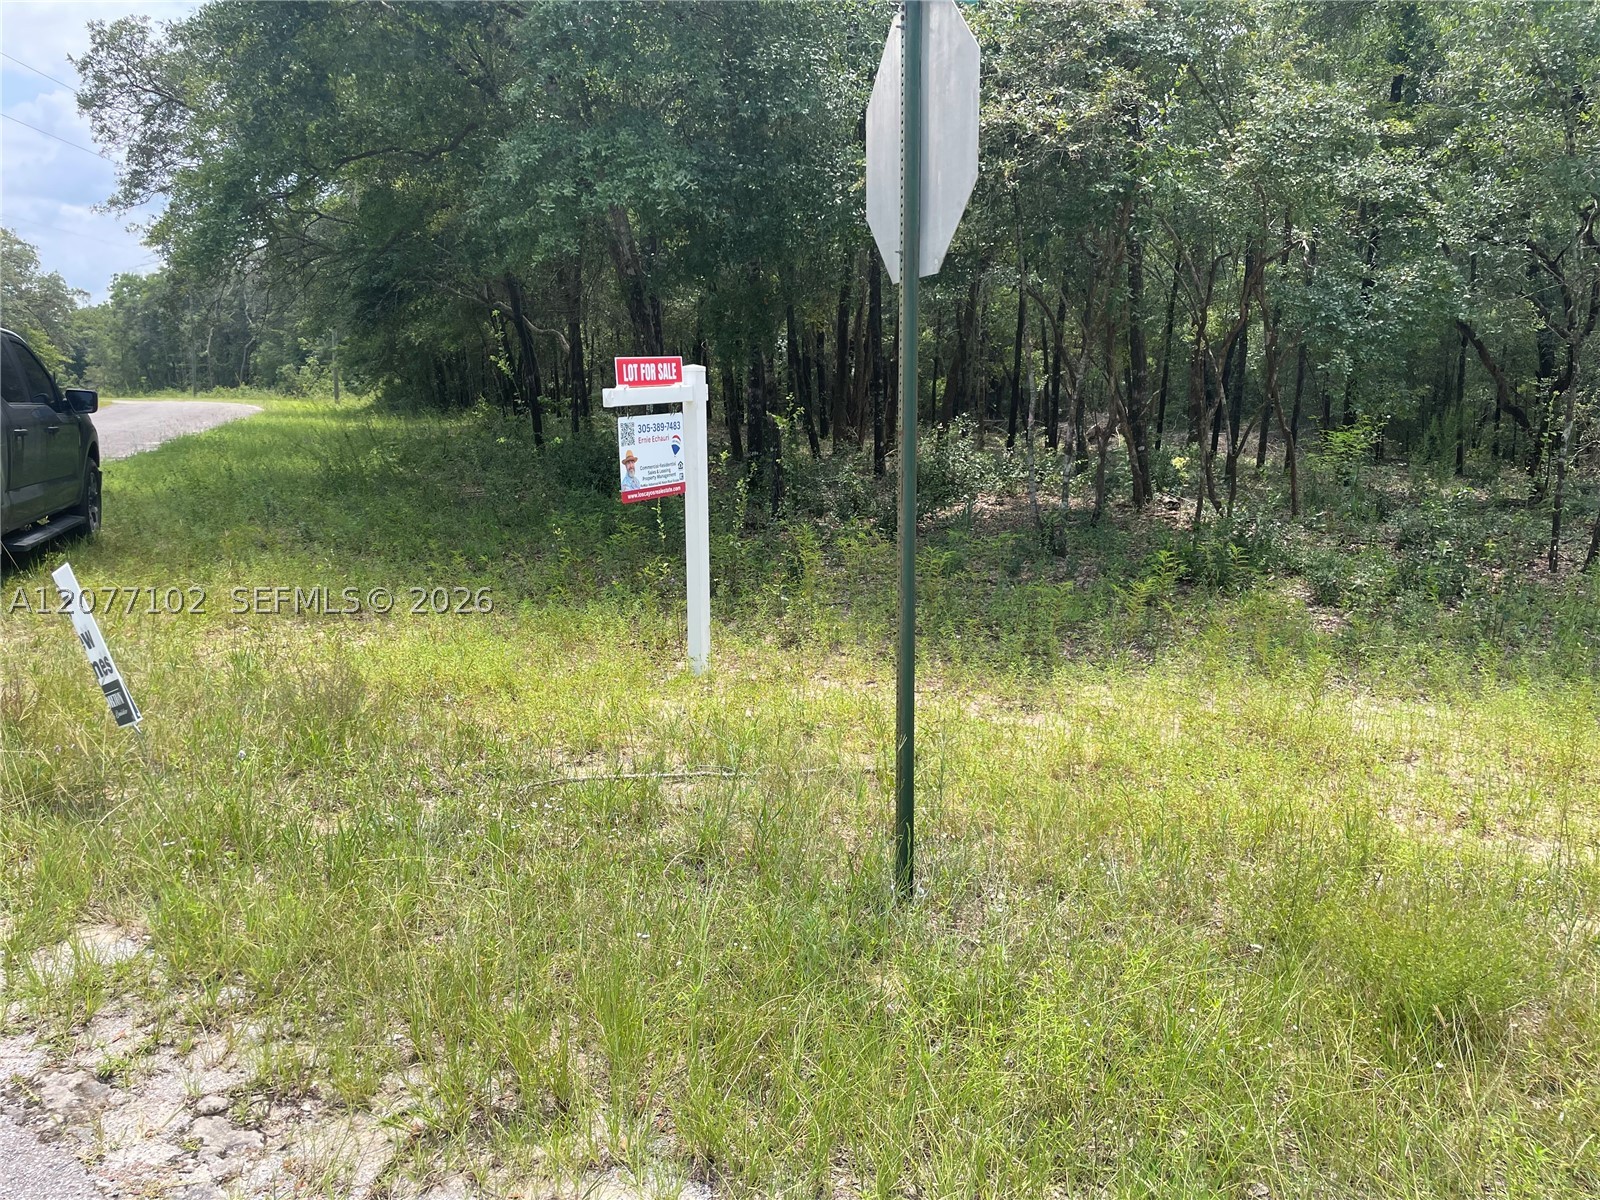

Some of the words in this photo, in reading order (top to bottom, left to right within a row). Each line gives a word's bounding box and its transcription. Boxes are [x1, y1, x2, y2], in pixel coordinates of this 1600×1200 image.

[623, 363, 637, 382] LOT
[640, 362, 656, 381] FOR
[658, 362, 677, 380] SALE
[637, 421, 681, 434] 305-389-7483
[638, 435, 651, 444] Ernie
